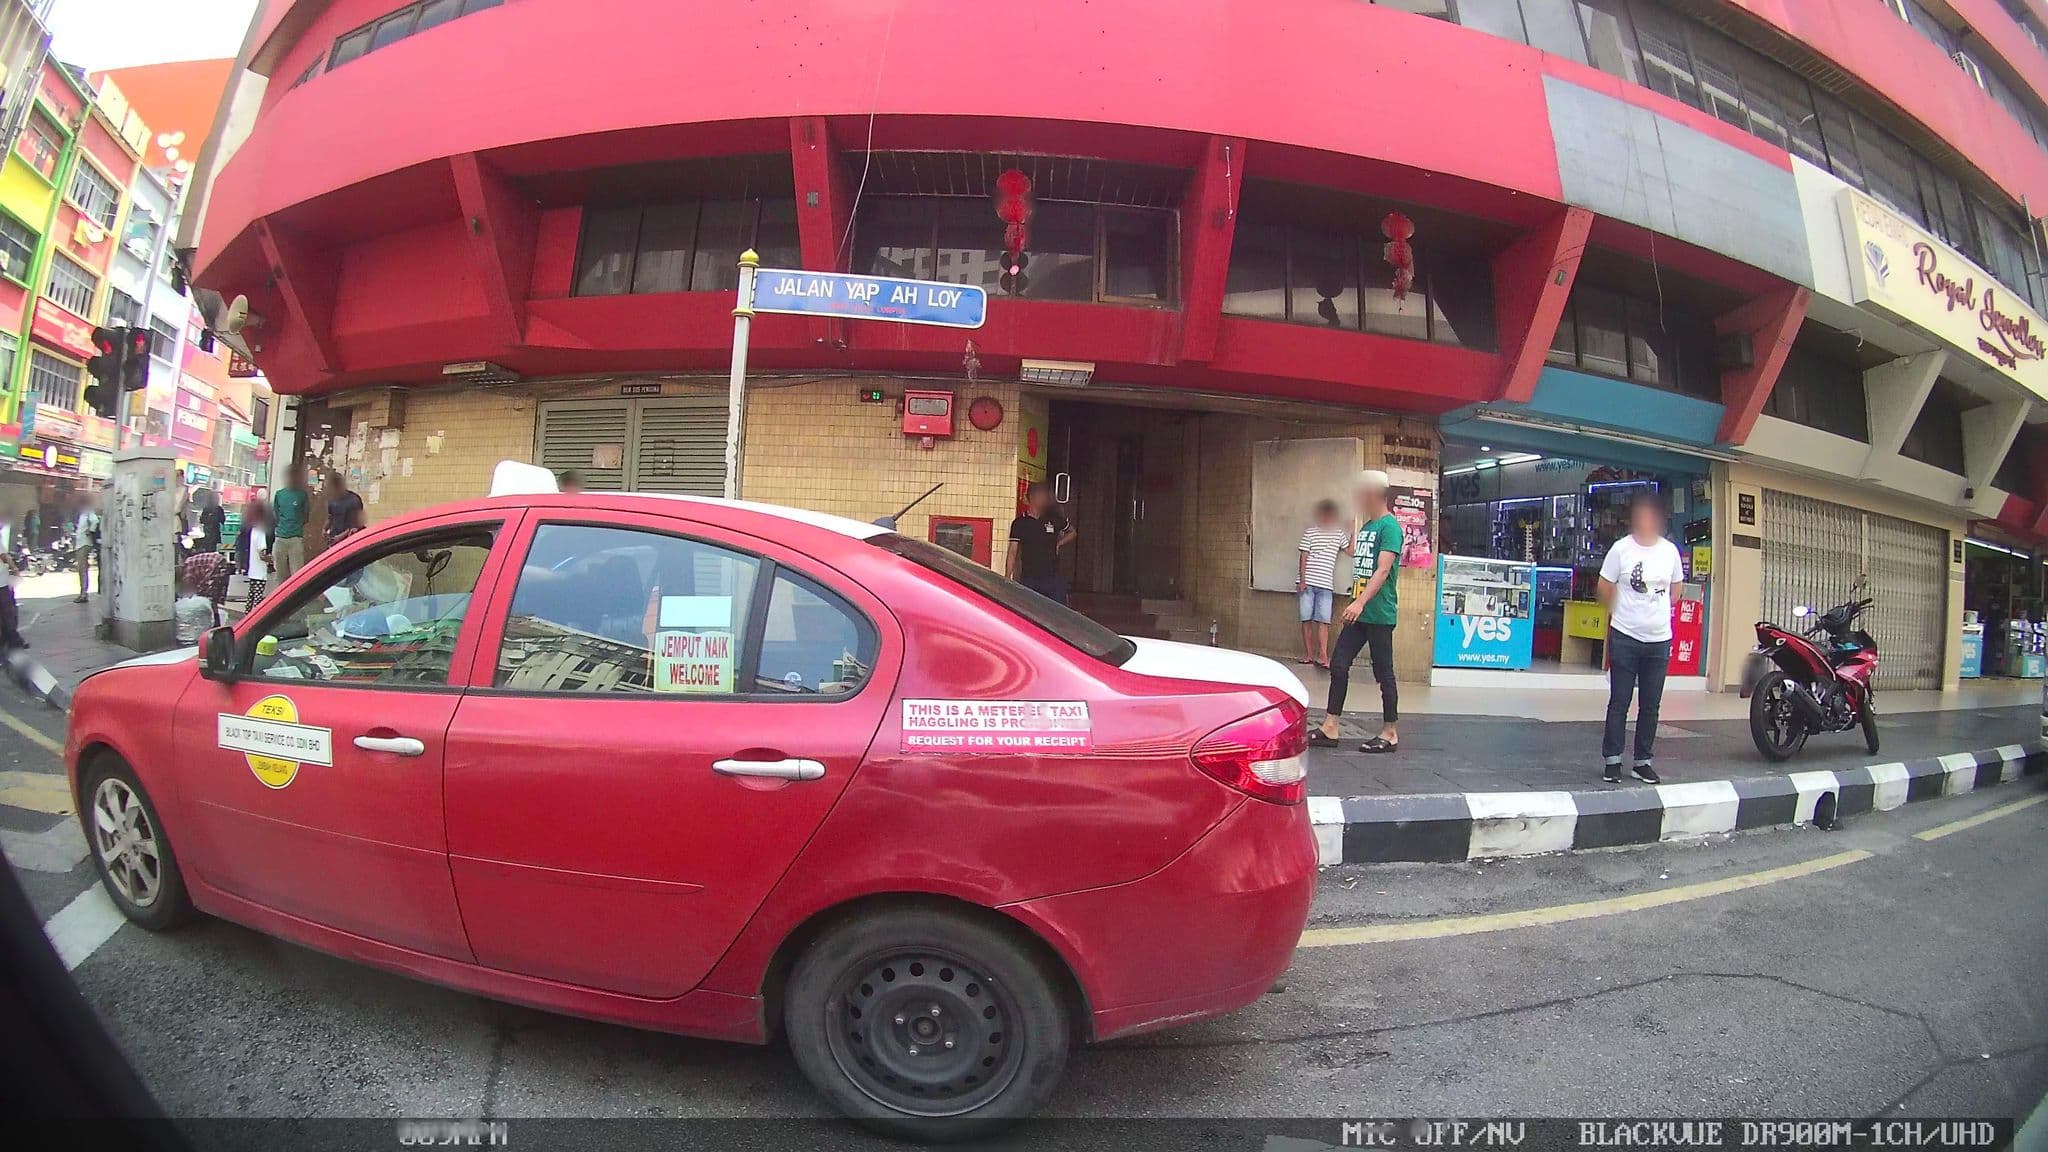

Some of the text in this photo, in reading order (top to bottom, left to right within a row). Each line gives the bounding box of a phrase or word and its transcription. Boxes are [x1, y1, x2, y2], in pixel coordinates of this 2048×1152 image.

[1913, 242, 1976, 311] Royal
[774, 278, 962, 309] JALAN YAP AH LOY
[1460, 615, 1511, 649] yes
[661, 636, 728, 658] JEMPUT NAIK
[1458, 653, 1510, 665] www.yes.my
[670, 663, 720, 685] WELCOME
[909, 704, 941, 715] THIS
[946, 705, 959, 715] IS
[964, 705, 973, 715] A
[1049, 706, 1082, 716] TAXI
[909, 717, 979, 727] HAGGLING
[984, 718, 996, 727] IS
[908, 735, 1086, 746] REQUEST FOR YOUR RECEIPT
